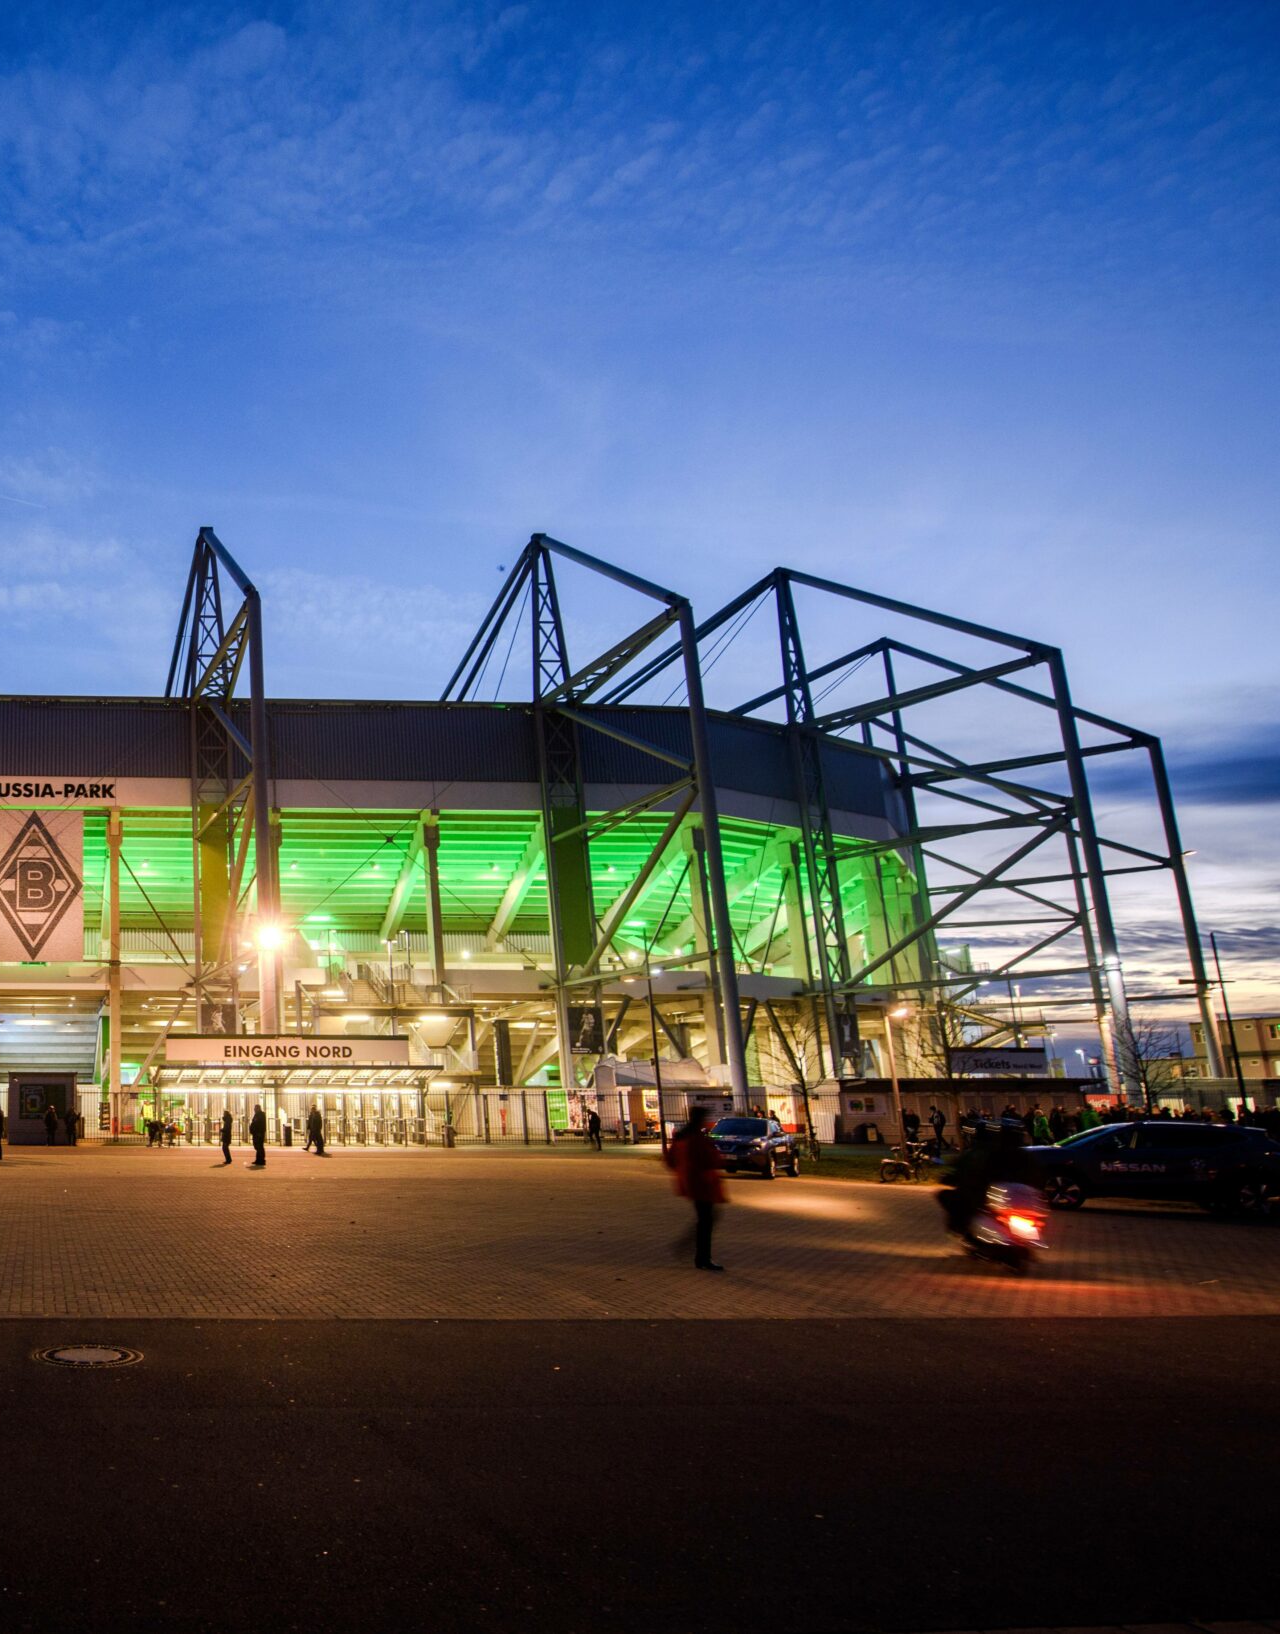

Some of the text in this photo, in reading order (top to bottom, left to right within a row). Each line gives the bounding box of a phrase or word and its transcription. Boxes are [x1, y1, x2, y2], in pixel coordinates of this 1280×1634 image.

[16, 859, 56, 911] B
[223, 1045, 353, 1058] EINGANG NORD
[973, 1058, 1011, 1070] Tickets
[1099, 1161, 1167, 1173] NISSAN
